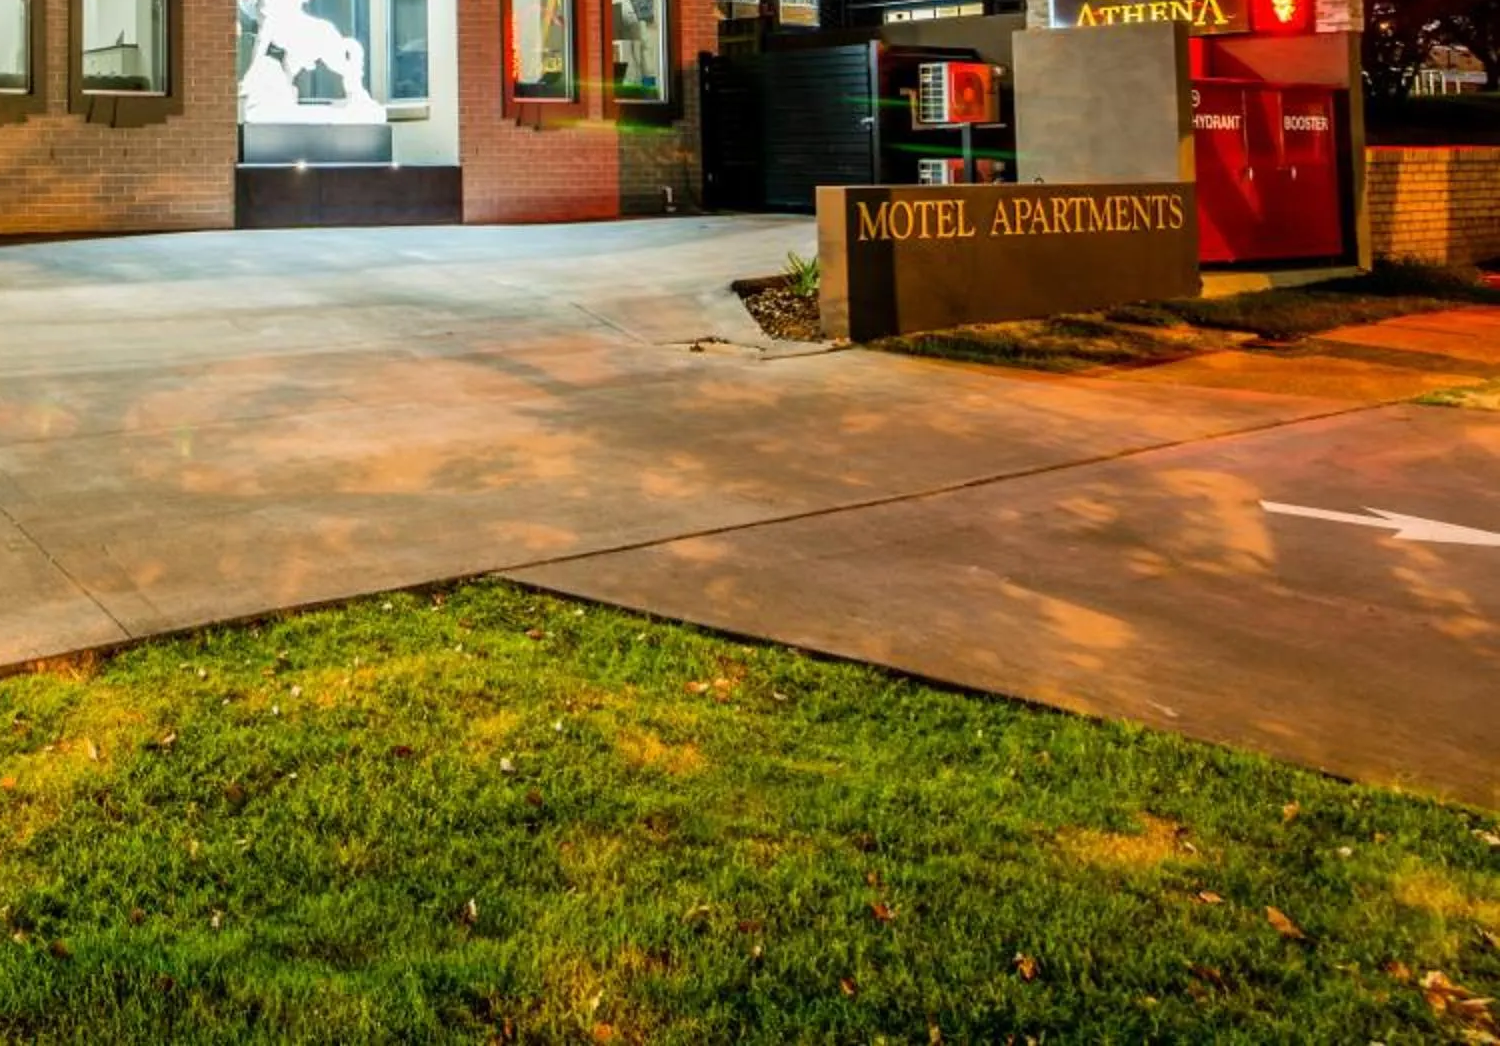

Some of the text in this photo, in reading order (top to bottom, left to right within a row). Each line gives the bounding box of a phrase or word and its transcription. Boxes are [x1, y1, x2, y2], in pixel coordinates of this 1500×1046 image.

[1191, 114, 1241, 130] HYDRANT
[1283, 115, 1329, 131] BOOSTER
[856, 194, 1184, 242] MOTEL APARTMENTS
